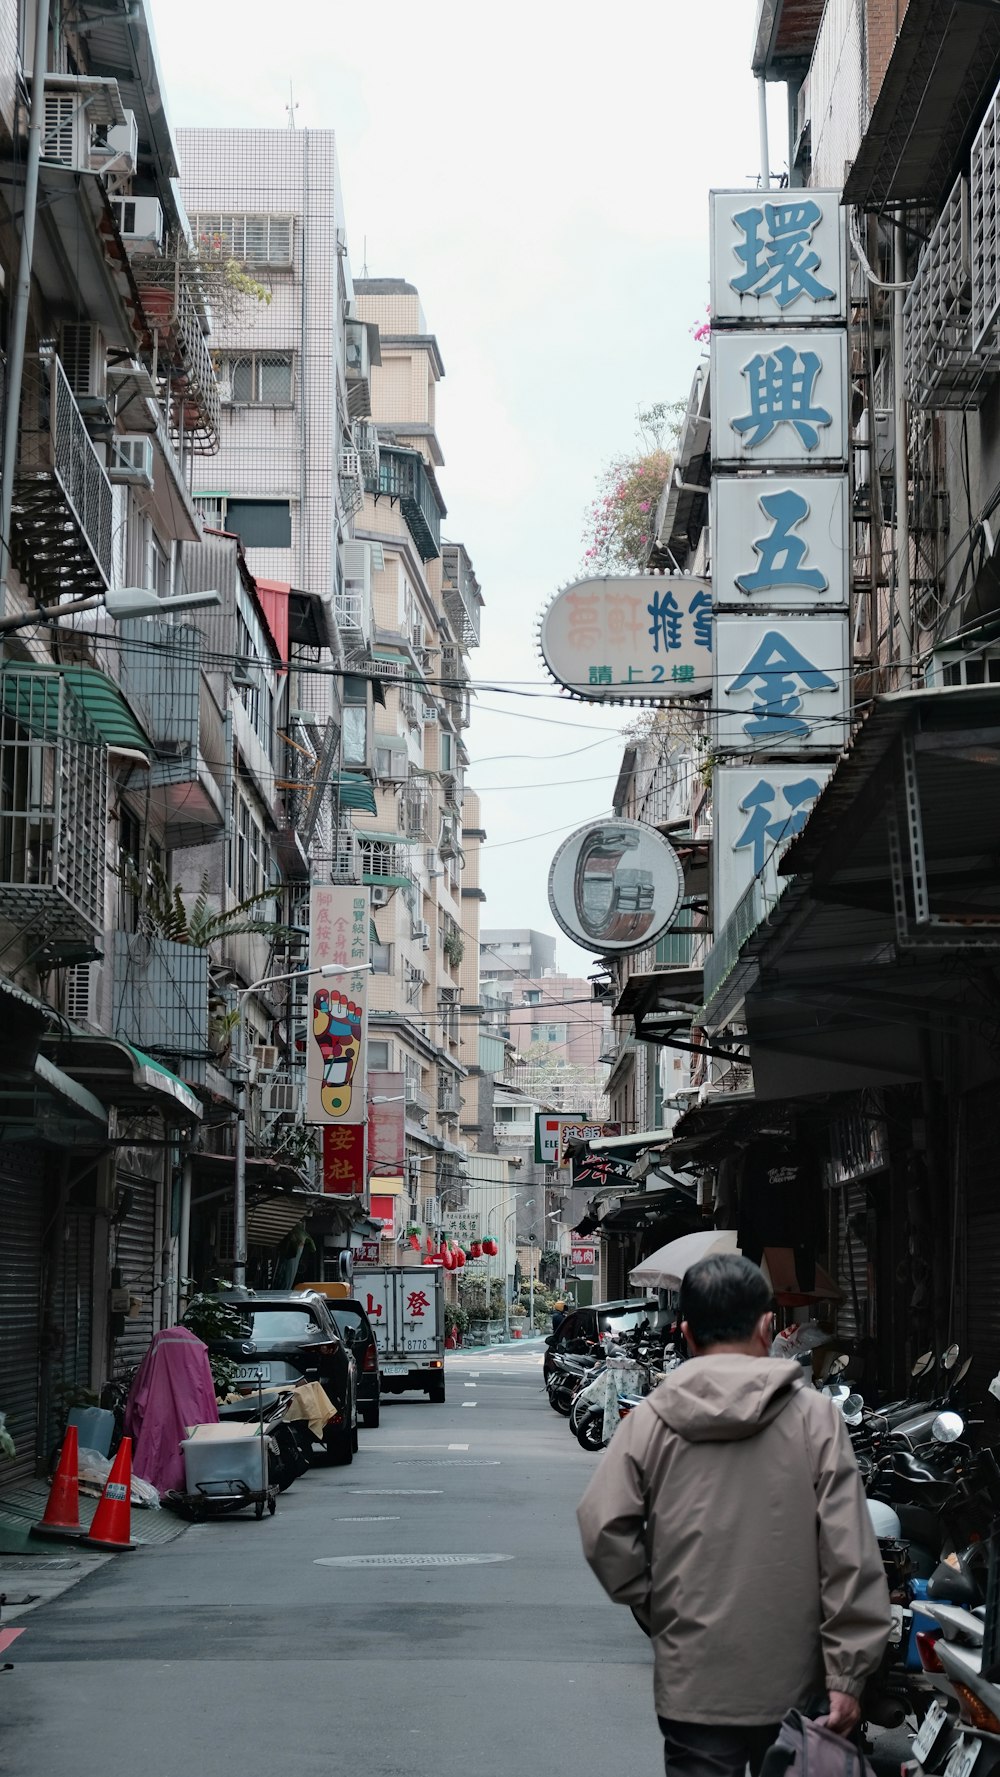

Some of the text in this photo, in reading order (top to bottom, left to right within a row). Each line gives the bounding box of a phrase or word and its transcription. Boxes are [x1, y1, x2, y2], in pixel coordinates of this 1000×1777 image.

[588, 664, 695, 684] 請上2樓
[407, 1340, 427, 1350] 8778
